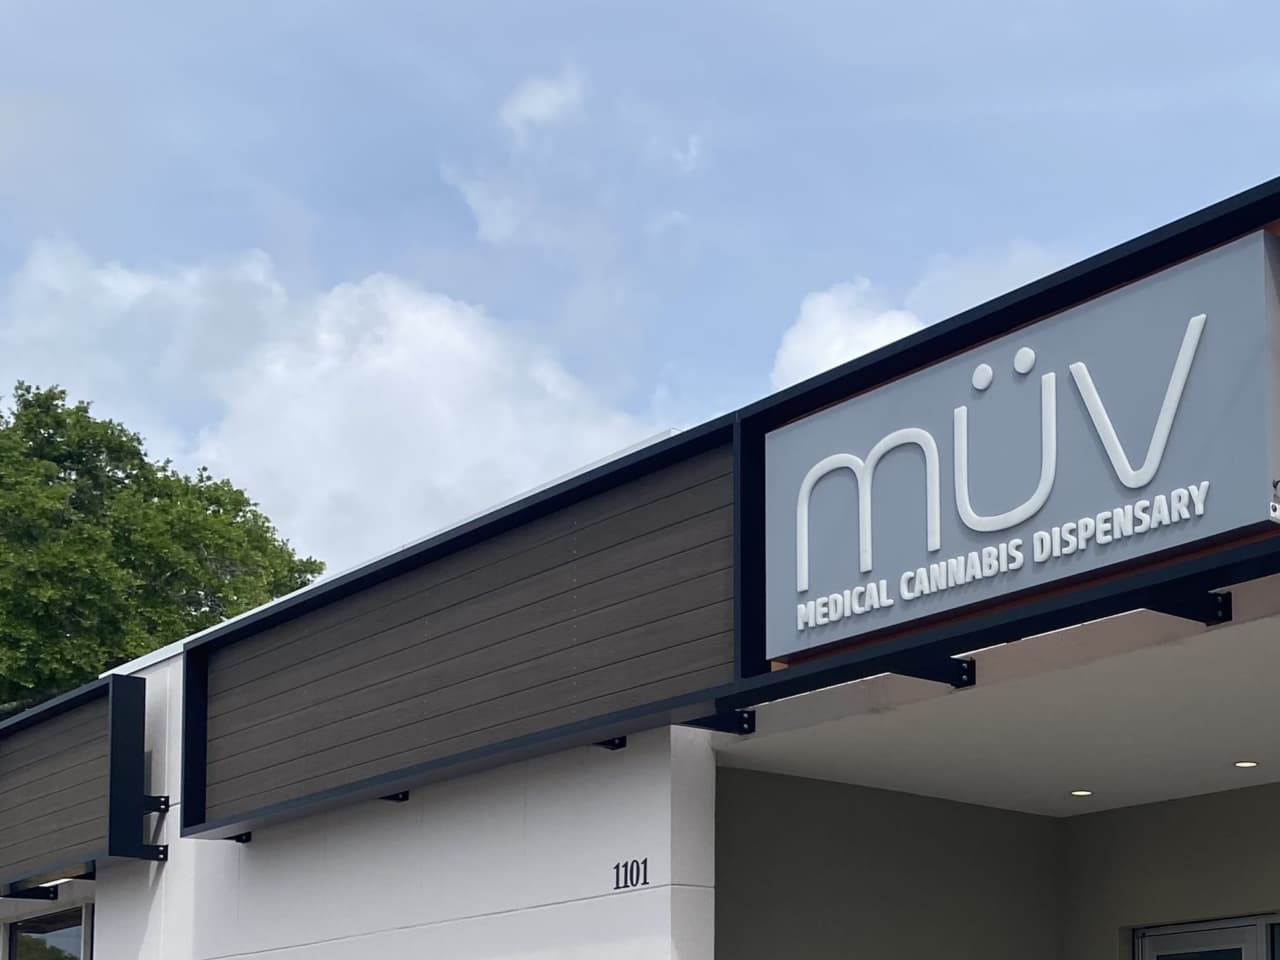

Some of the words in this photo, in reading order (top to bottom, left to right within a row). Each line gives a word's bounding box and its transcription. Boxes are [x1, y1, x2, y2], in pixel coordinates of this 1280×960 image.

[796, 579, 895, 631] MEDICAL
[900, 537, 1024, 599] CANNABIS
[1032, 481, 1210, 563] DISPENSARY
[613, 857, 650, 890] 1101
